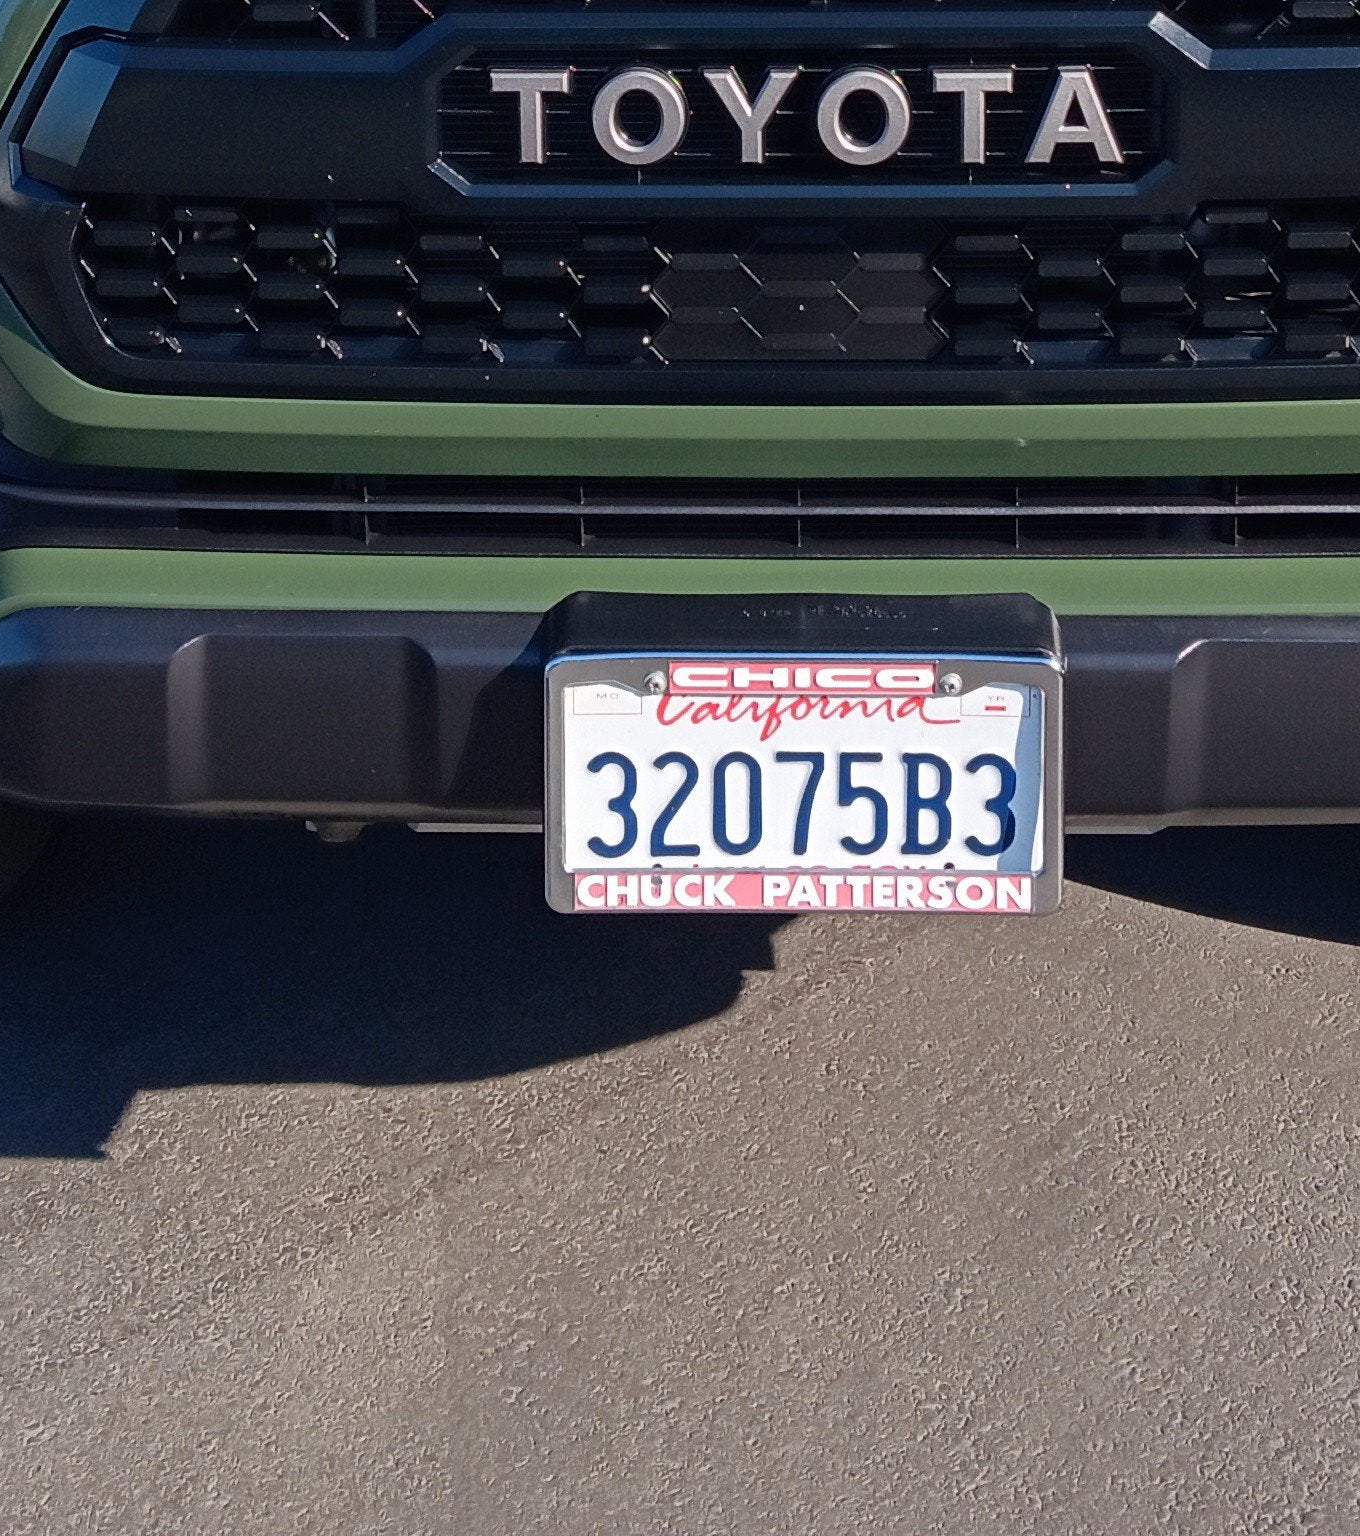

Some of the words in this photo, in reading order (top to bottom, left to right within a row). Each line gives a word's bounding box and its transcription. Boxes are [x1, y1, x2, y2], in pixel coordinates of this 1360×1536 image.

[490, 64, 1125, 165] TOYOTA
[671, 666, 935, 690] CHICO
[656, 694, 960, 742] California
[587, 750, 1017, 858] 32075B3
[576, 874, 737, 908] CHUCK
[762, 875, 1032, 911] PATTERSON
